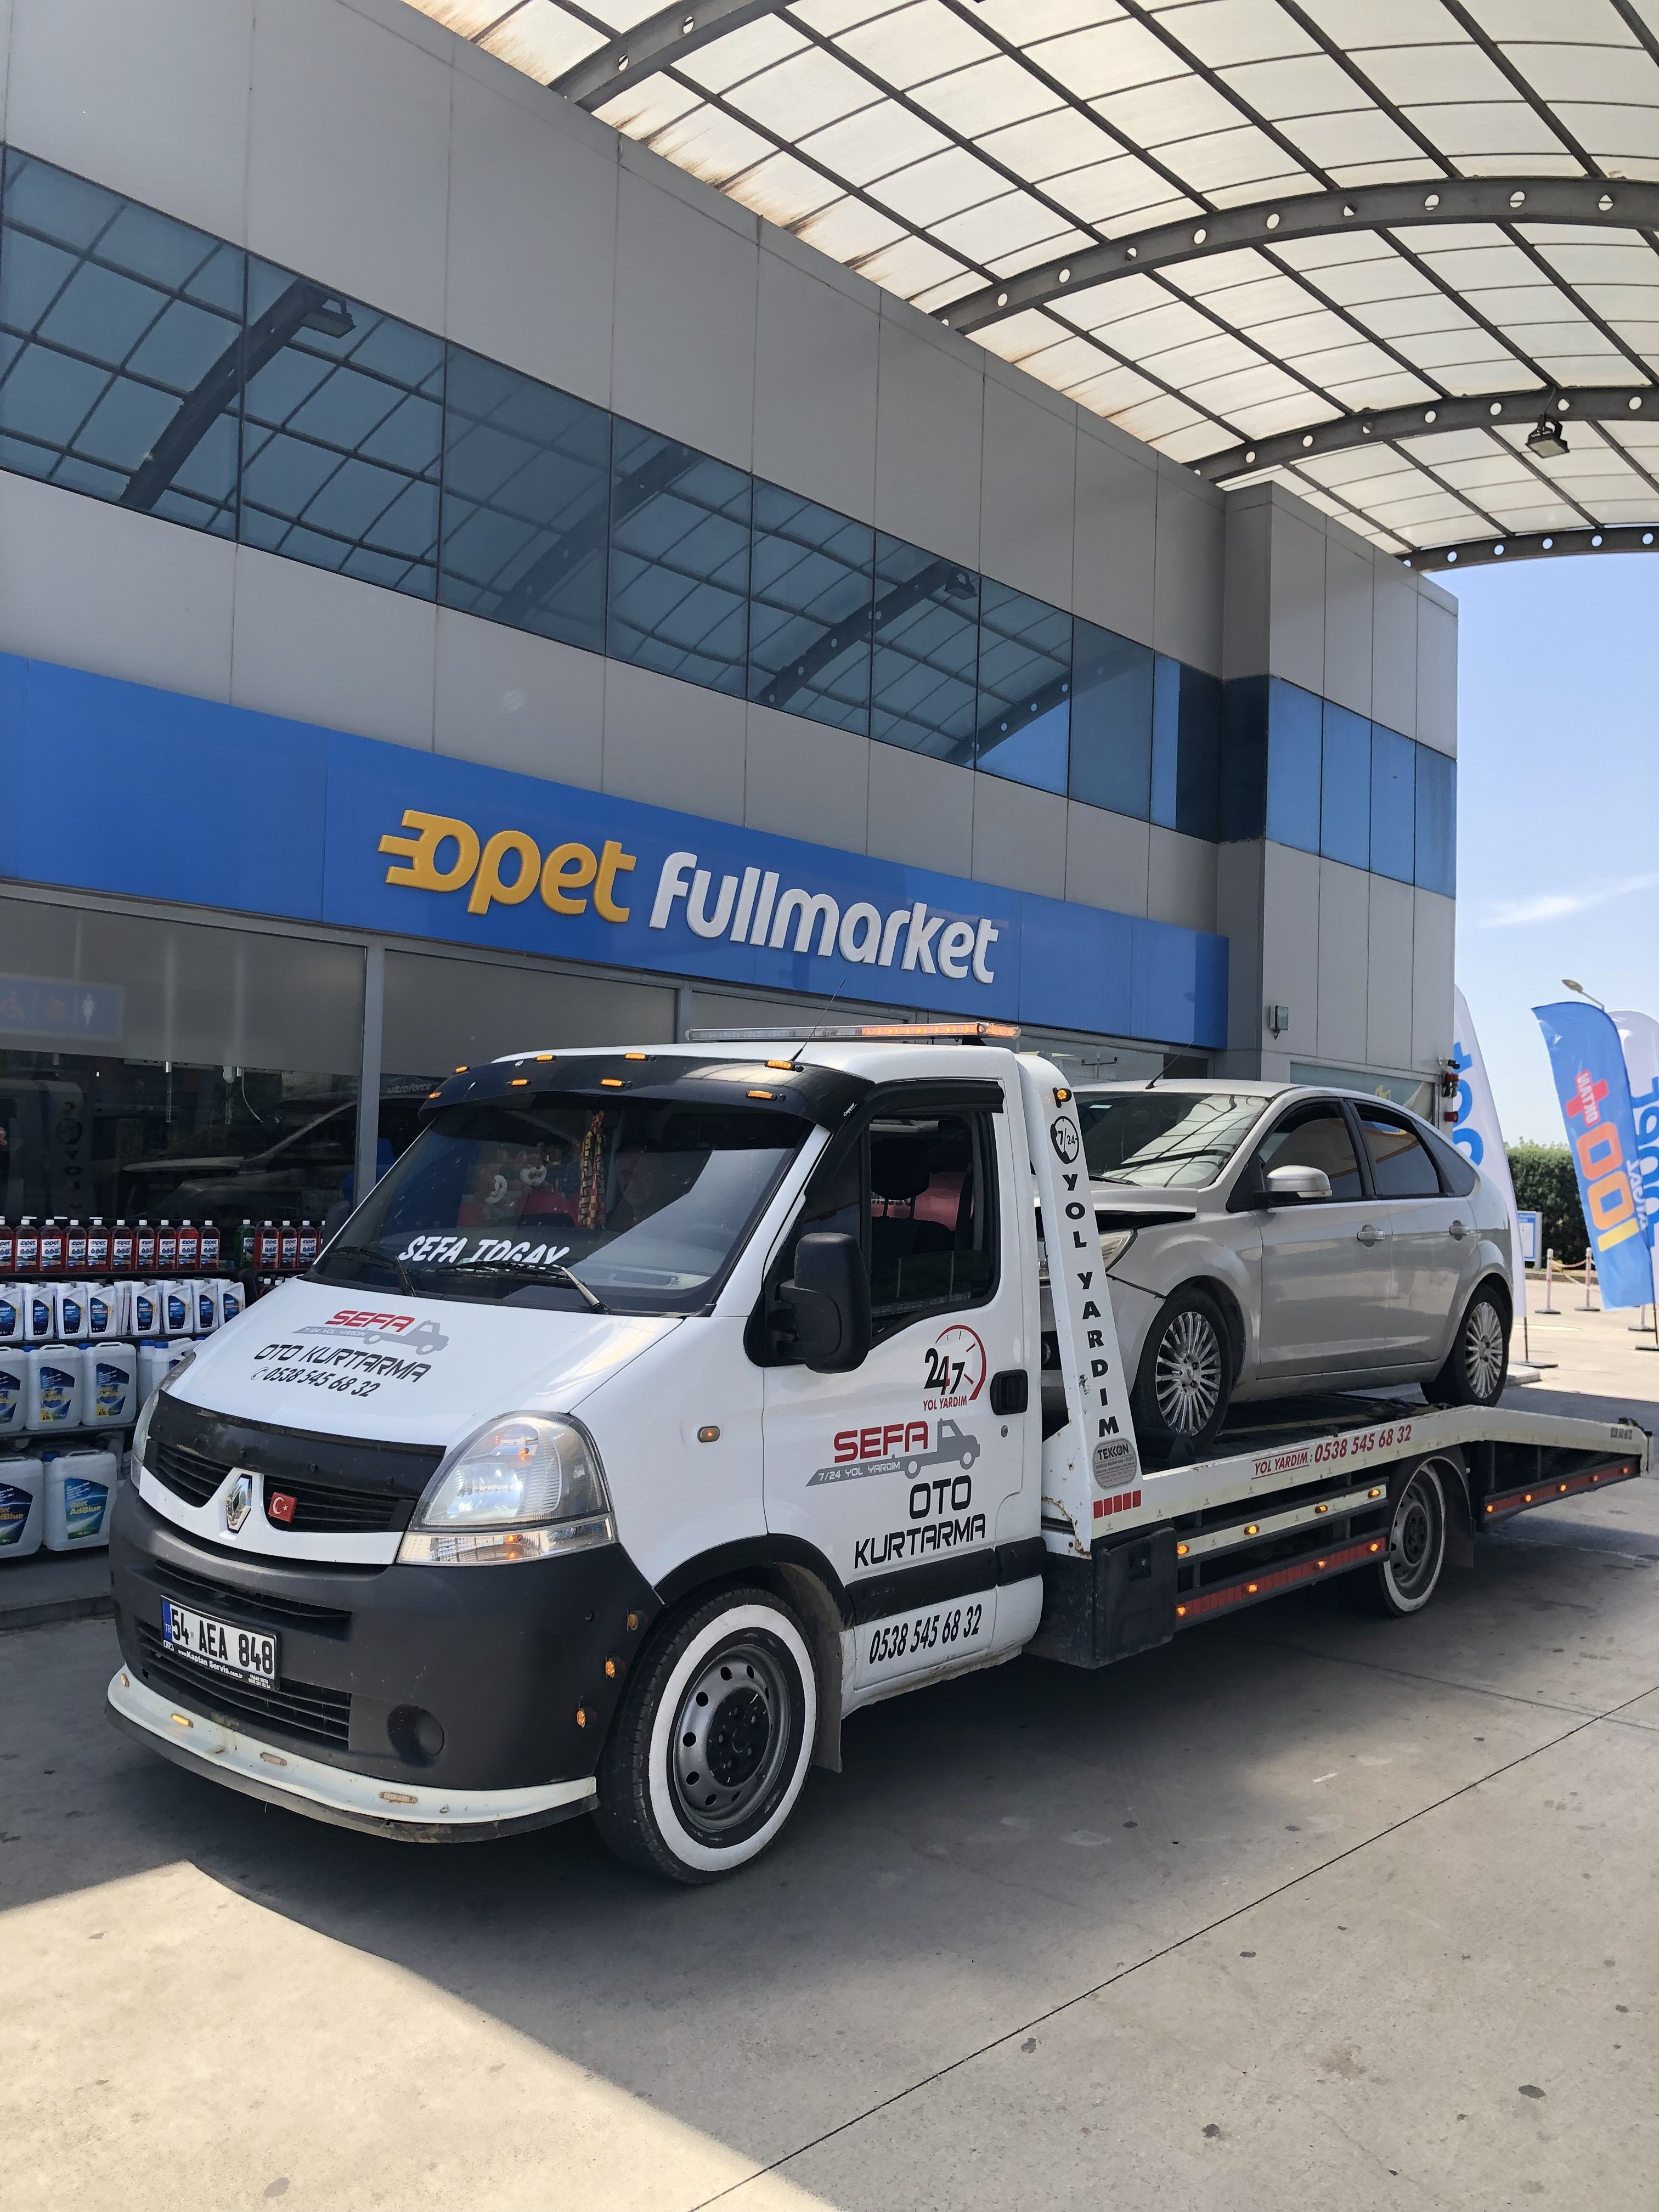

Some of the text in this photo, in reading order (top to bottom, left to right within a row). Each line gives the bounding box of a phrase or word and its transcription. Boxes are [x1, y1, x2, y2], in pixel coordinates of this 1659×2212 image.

[379, 809, 998, 984] opet fullmarket
[398, 1235, 468, 1263] SEFA
[324, 1310, 415, 1332] SEFA
[1062, 1173, 1087, 1248] YOL
[1077, 1271, 1119, 1437] YARDIM
[254, 1344, 432, 1383] OTO KURTARMA
[262, 1367, 381, 1397] 0538 545 68 32
[923, 1395, 967, 1412] YOL YARDIM
[834, 1421, 928, 1463] SEFA
[1255, 1461, 1271, 1475] YOL
[1314, 1438, 1348, 1463] 0538
[1351, 1432, 1375, 1455] 545
[1379, 1429, 1393, 1448] 68
[1397, 1424, 1412, 1444] 32
[819, 1462, 900, 1481] 7/24 YOL YARDIM
[70, 1505, 101, 1515] AdBlue
[910, 1475, 972, 1519] OTO
[855, 1513, 986, 1568] KURTARMA
[165, 1623, 172, 1634] TR
[171, 1608, 273, 1674] 54 AEA 848
[869, 1604, 982, 1664] 0538 545 68 32
